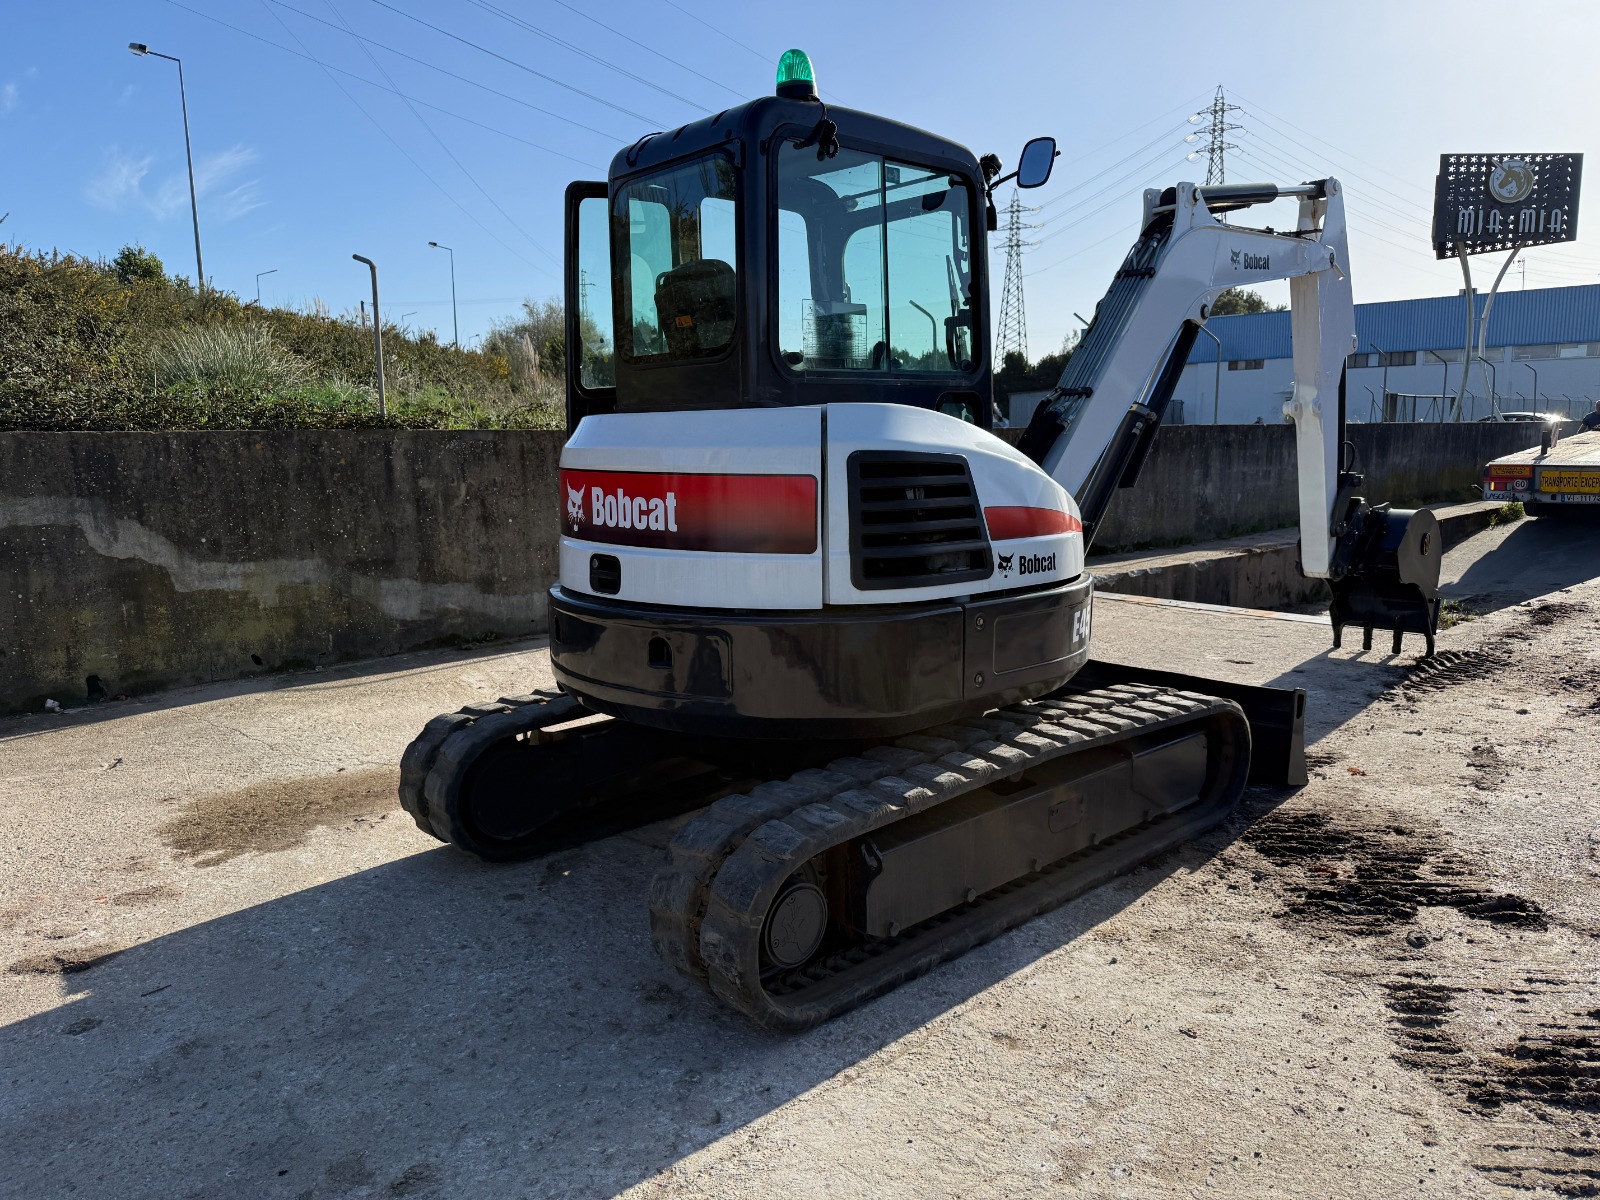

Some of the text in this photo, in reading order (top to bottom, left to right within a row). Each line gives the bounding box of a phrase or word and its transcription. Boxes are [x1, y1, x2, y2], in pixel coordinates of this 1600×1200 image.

[1457, 208, 1562, 234] MIA MIA
[1243, 252, 1270, 271] Bobcat
[1515, 480, 1526, 489] 60
[1541, 476, 1600, 488] TRANSPORTE EXCEP
[591, 486, 678, 532] Bobcat
[1018, 552, 1057, 575] Bobcat
